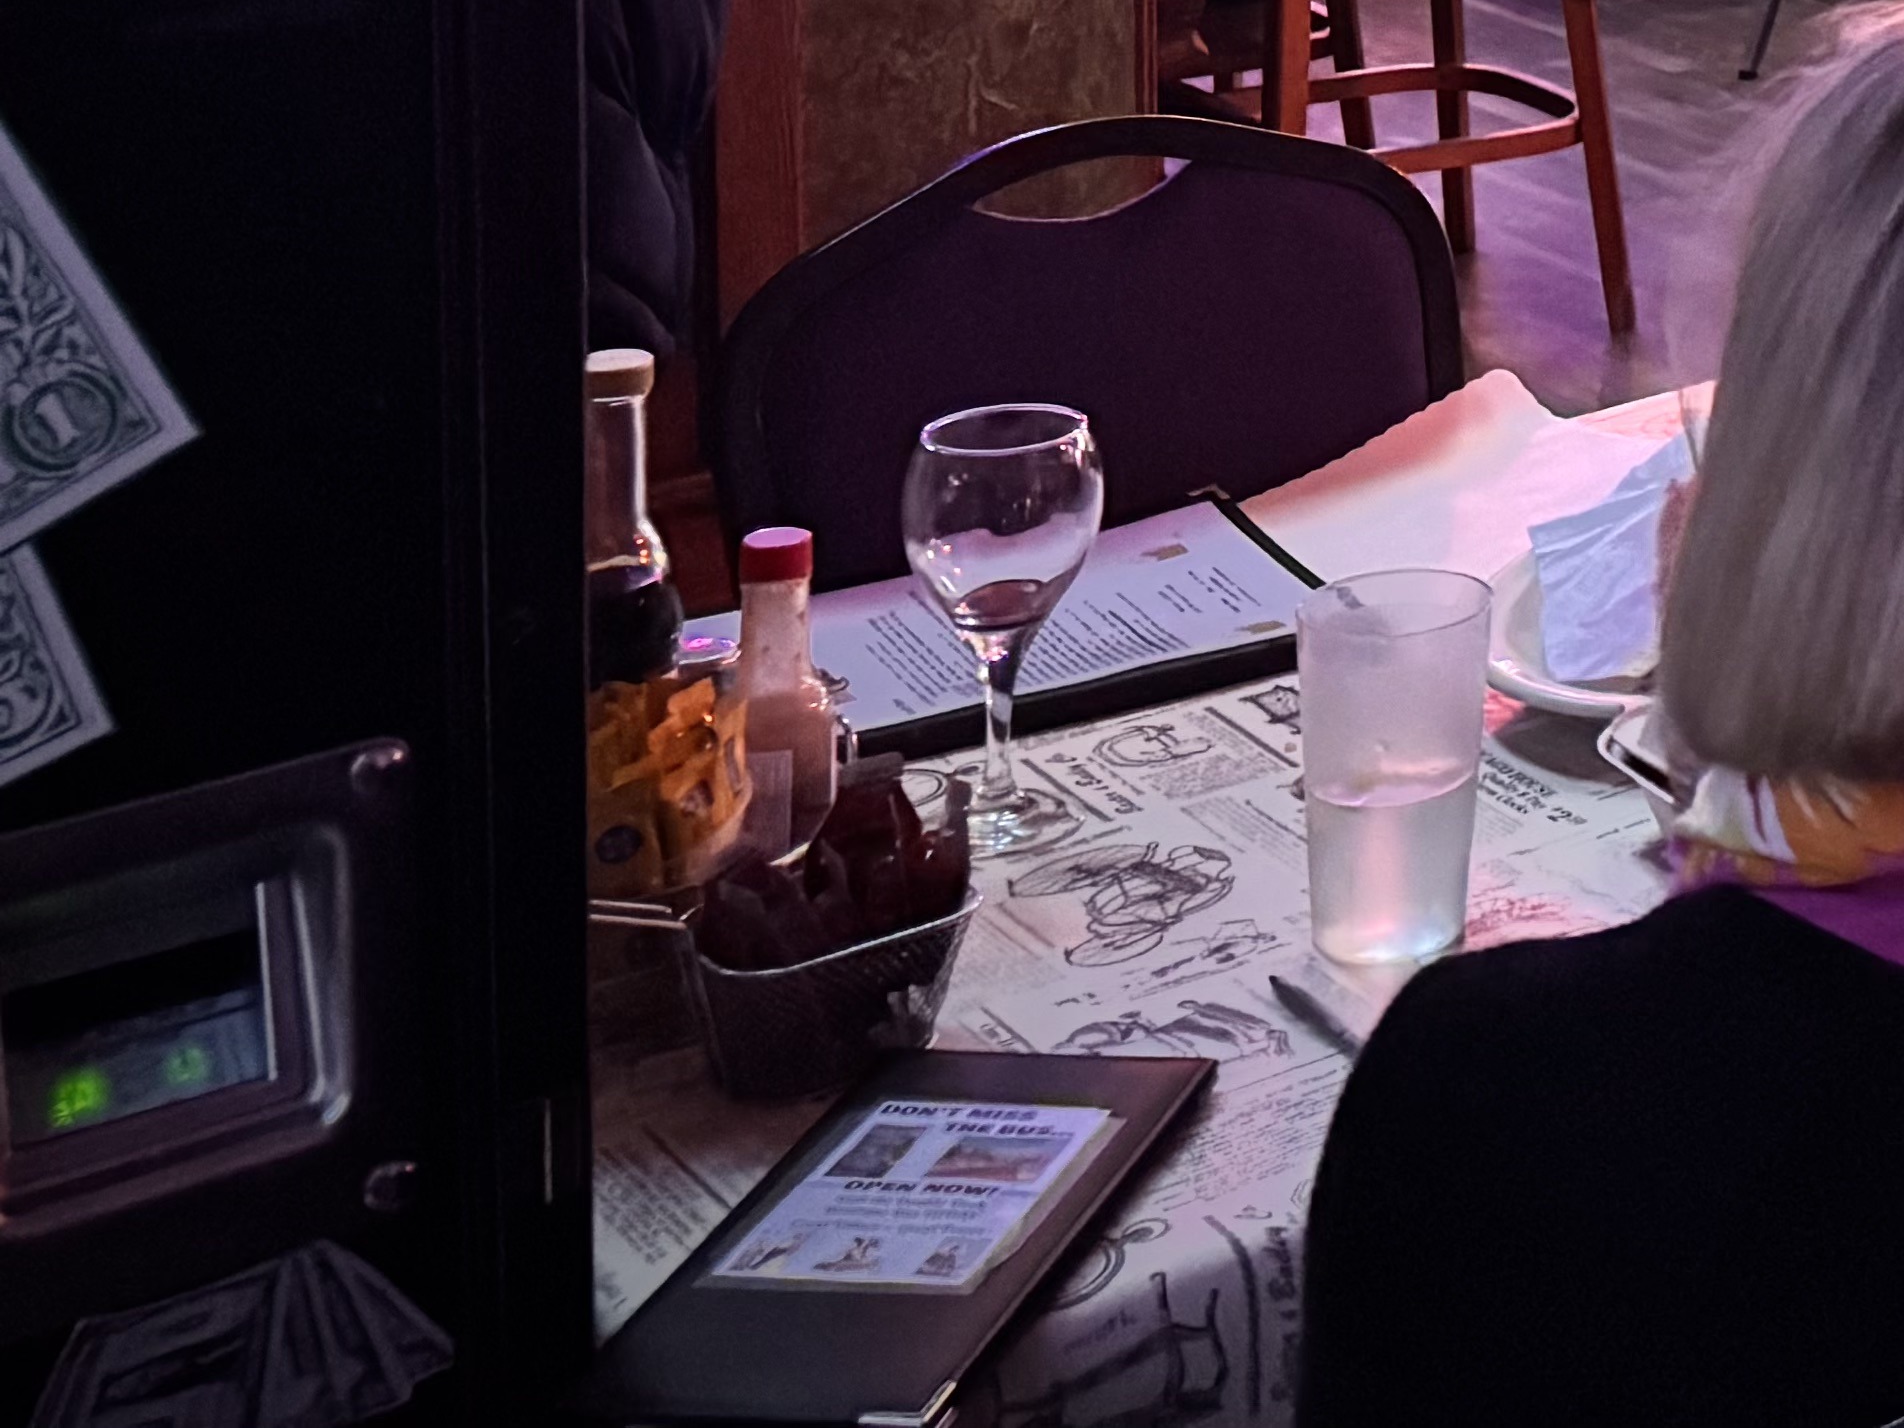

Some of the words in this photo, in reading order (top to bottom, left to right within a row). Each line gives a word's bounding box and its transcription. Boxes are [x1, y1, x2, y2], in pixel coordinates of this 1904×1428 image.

[876, 1103, 959, 1121] DON'T
[960, 1106, 1038, 1123] MISS
[943, 1121, 990, 1136] THE
[843, 1179, 919, 1196] OPEN
[923, 1182, 1001, 1198] NOW!
